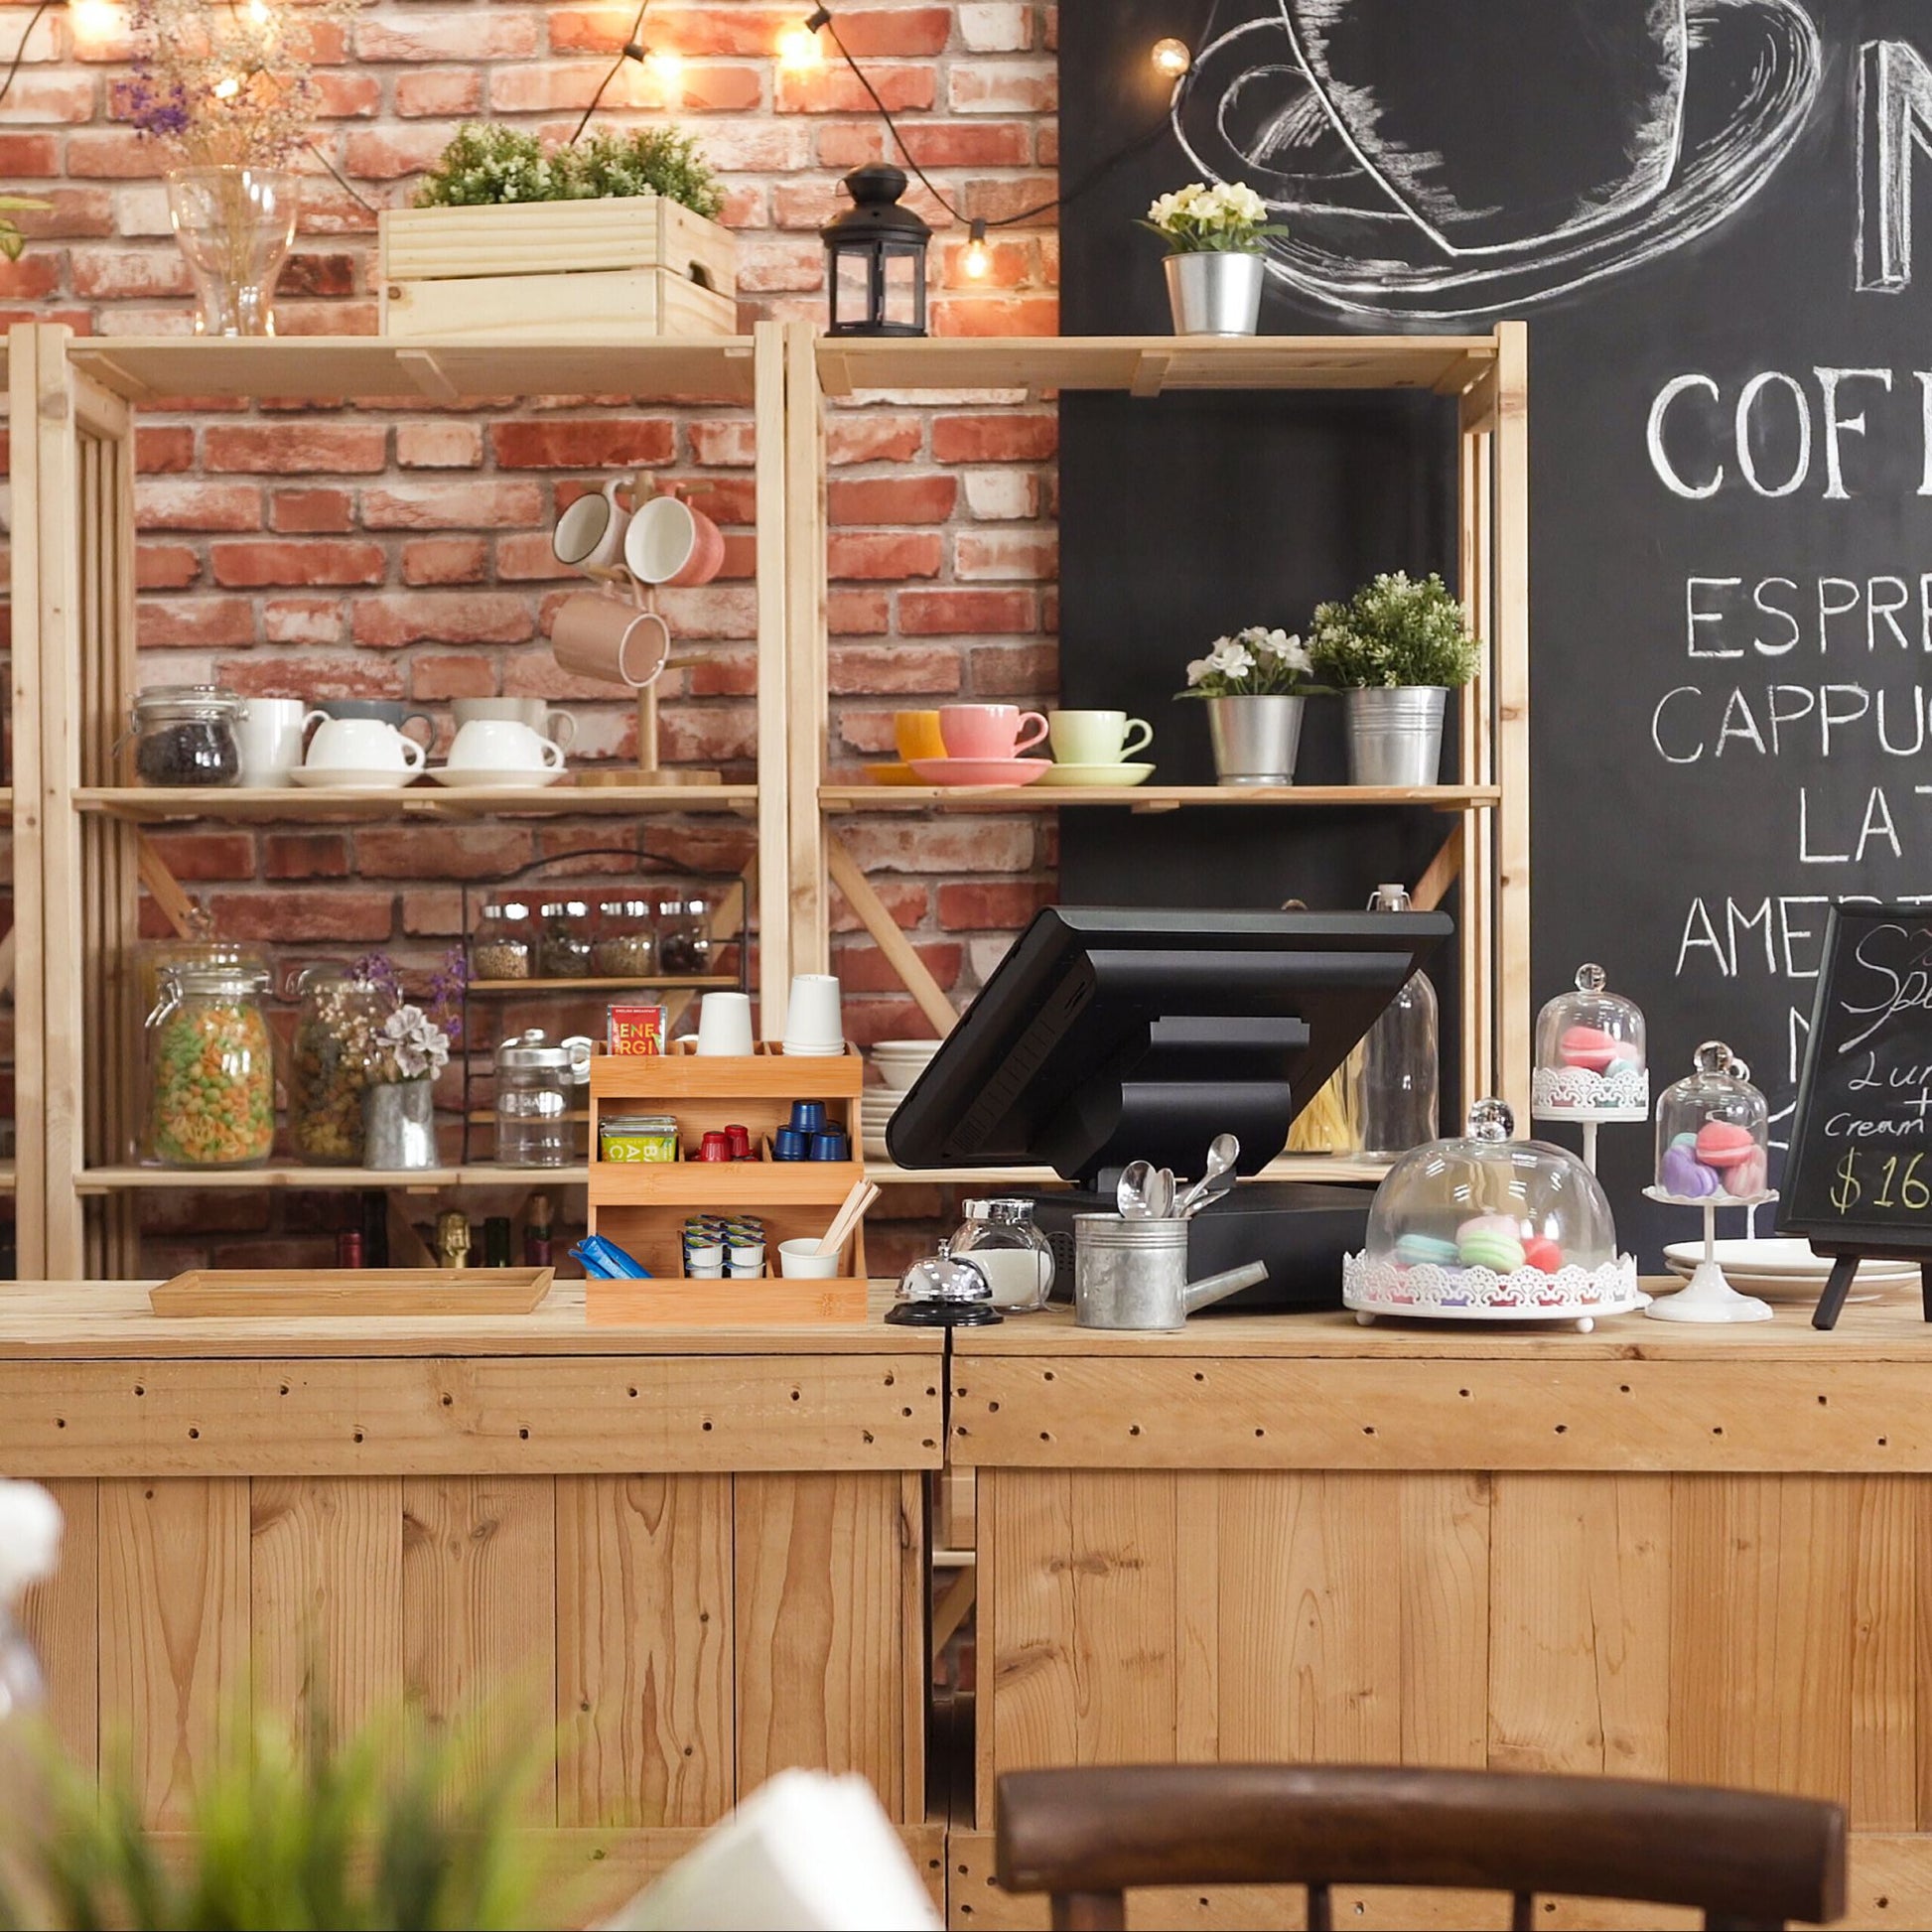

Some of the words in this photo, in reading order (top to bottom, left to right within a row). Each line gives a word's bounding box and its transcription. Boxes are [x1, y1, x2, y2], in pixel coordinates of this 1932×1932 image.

[1689, 573, 1932, 657] ESPR
[1652, 682, 1932, 763] CAPPU
[1800, 785, 1932, 863] LA
[1675, 896, 1932, 978] AME
[620, 1023, 655, 1038] ENE
[620, 1039, 653, 1055] RGI
[1825, 1112, 1924, 1137] Cream
